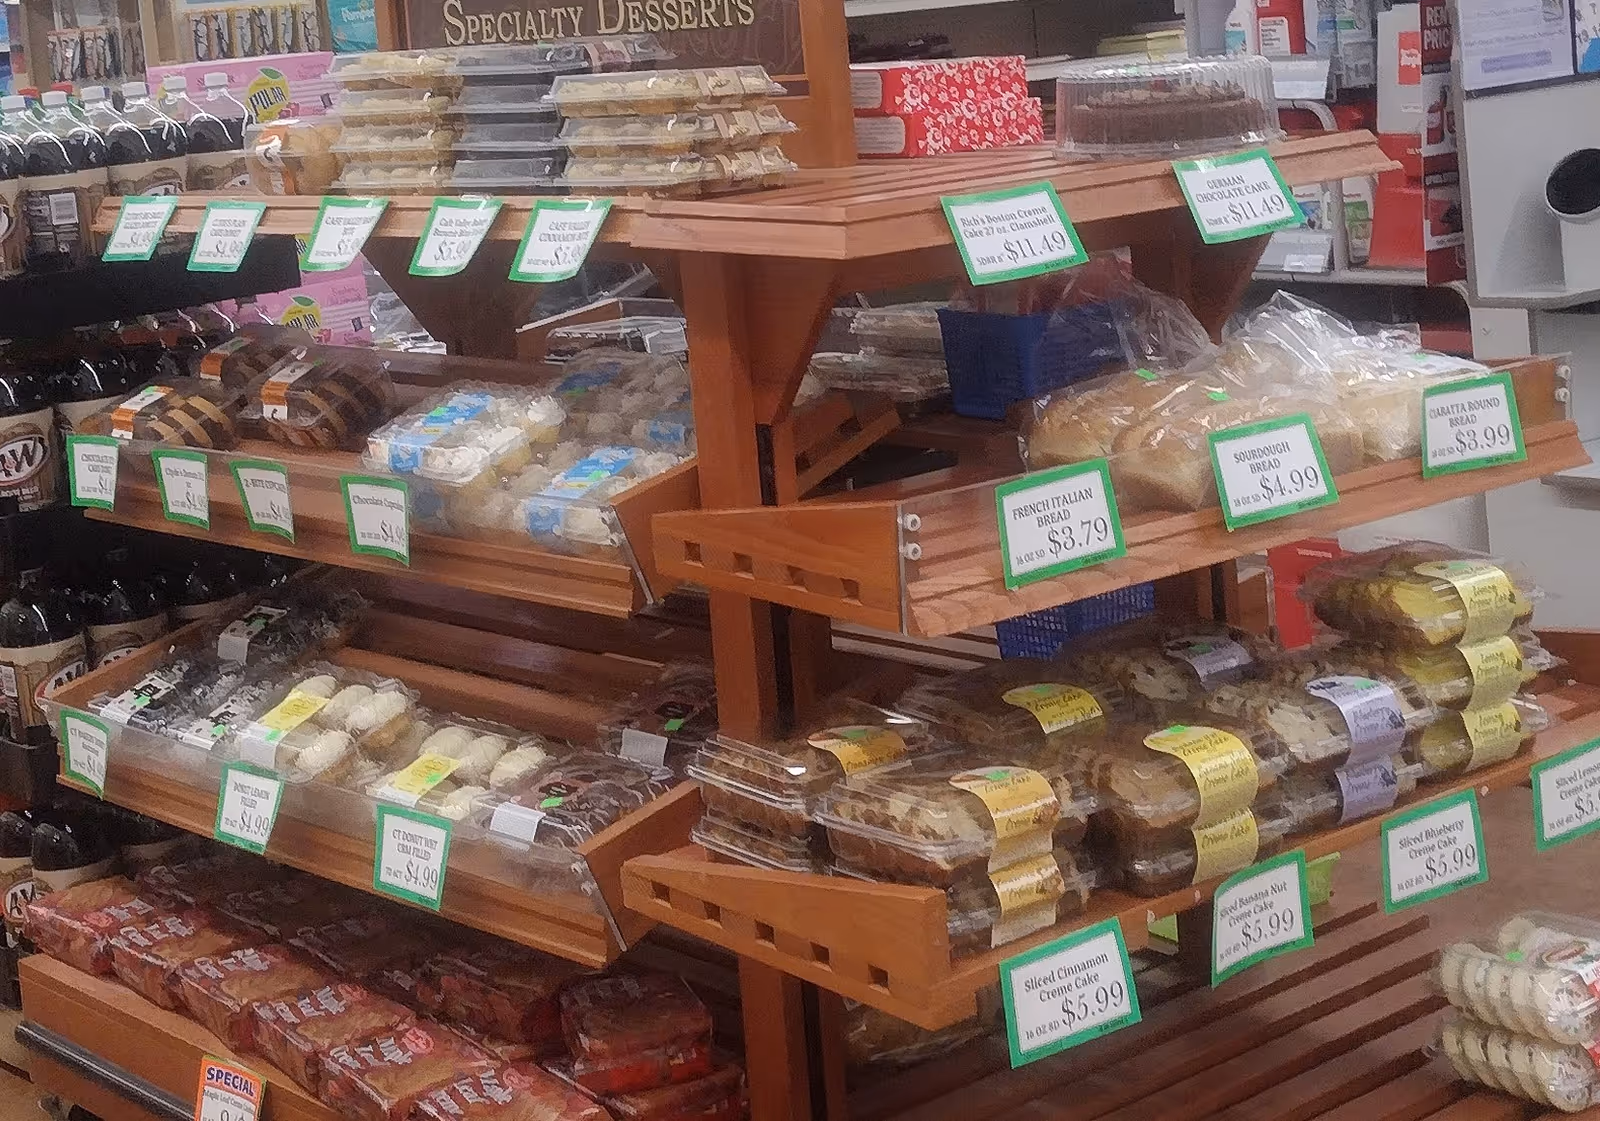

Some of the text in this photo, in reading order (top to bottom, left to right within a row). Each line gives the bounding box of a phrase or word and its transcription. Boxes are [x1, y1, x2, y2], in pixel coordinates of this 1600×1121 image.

[443, 0, 755, 46] SPECIALTY DESSERTS
[248, 87, 287, 116] POLAR
[1195, 180, 1272, 204] CHOCOLATE CAKE
[1206, 174, 1246, 190] GERMAN
[960, 213, 985, 228] Rich's
[1227, 193, 1286, 224] $11.49
[963, 227, 984, 239] Cake
[1009, 213, 1056, 232] Clamshell
[1003, 229, 1067, 263] $11.49
[1467, 396, 1501, 413] ROUND
[1448, 413, 1478, 428] BREAD
[1233, 441, 1291, 464] SOURDOUGH
[1455, 423, 1512, 457] $3.99
[1249, 457, 1281, 475] BREAD
[1259, 465, 1319, 505] $4.99
[1012, 487, 1094, 521] FRENCH ITALIAN
[1036, 508, 1071, 528] BREAD
[1047, 516, 1109, 559] $3.79
[1436, 835, 1458, 851] Cake
[404, 859, 439, 891] $4.99
[1424, 843, 1477, 884] $5.99
[1270, 880, 1288, 896] Nut
[1241, 908, 1295, 954] $5.99
[1024, 953, 1109, 993] Sliced Cinnamon
[1039, 971, 1100, 1003] Creme Cake
[1061, 980, 1124, 1031] $5.99
[206, 1066, 254, 1097] SPECIAL
